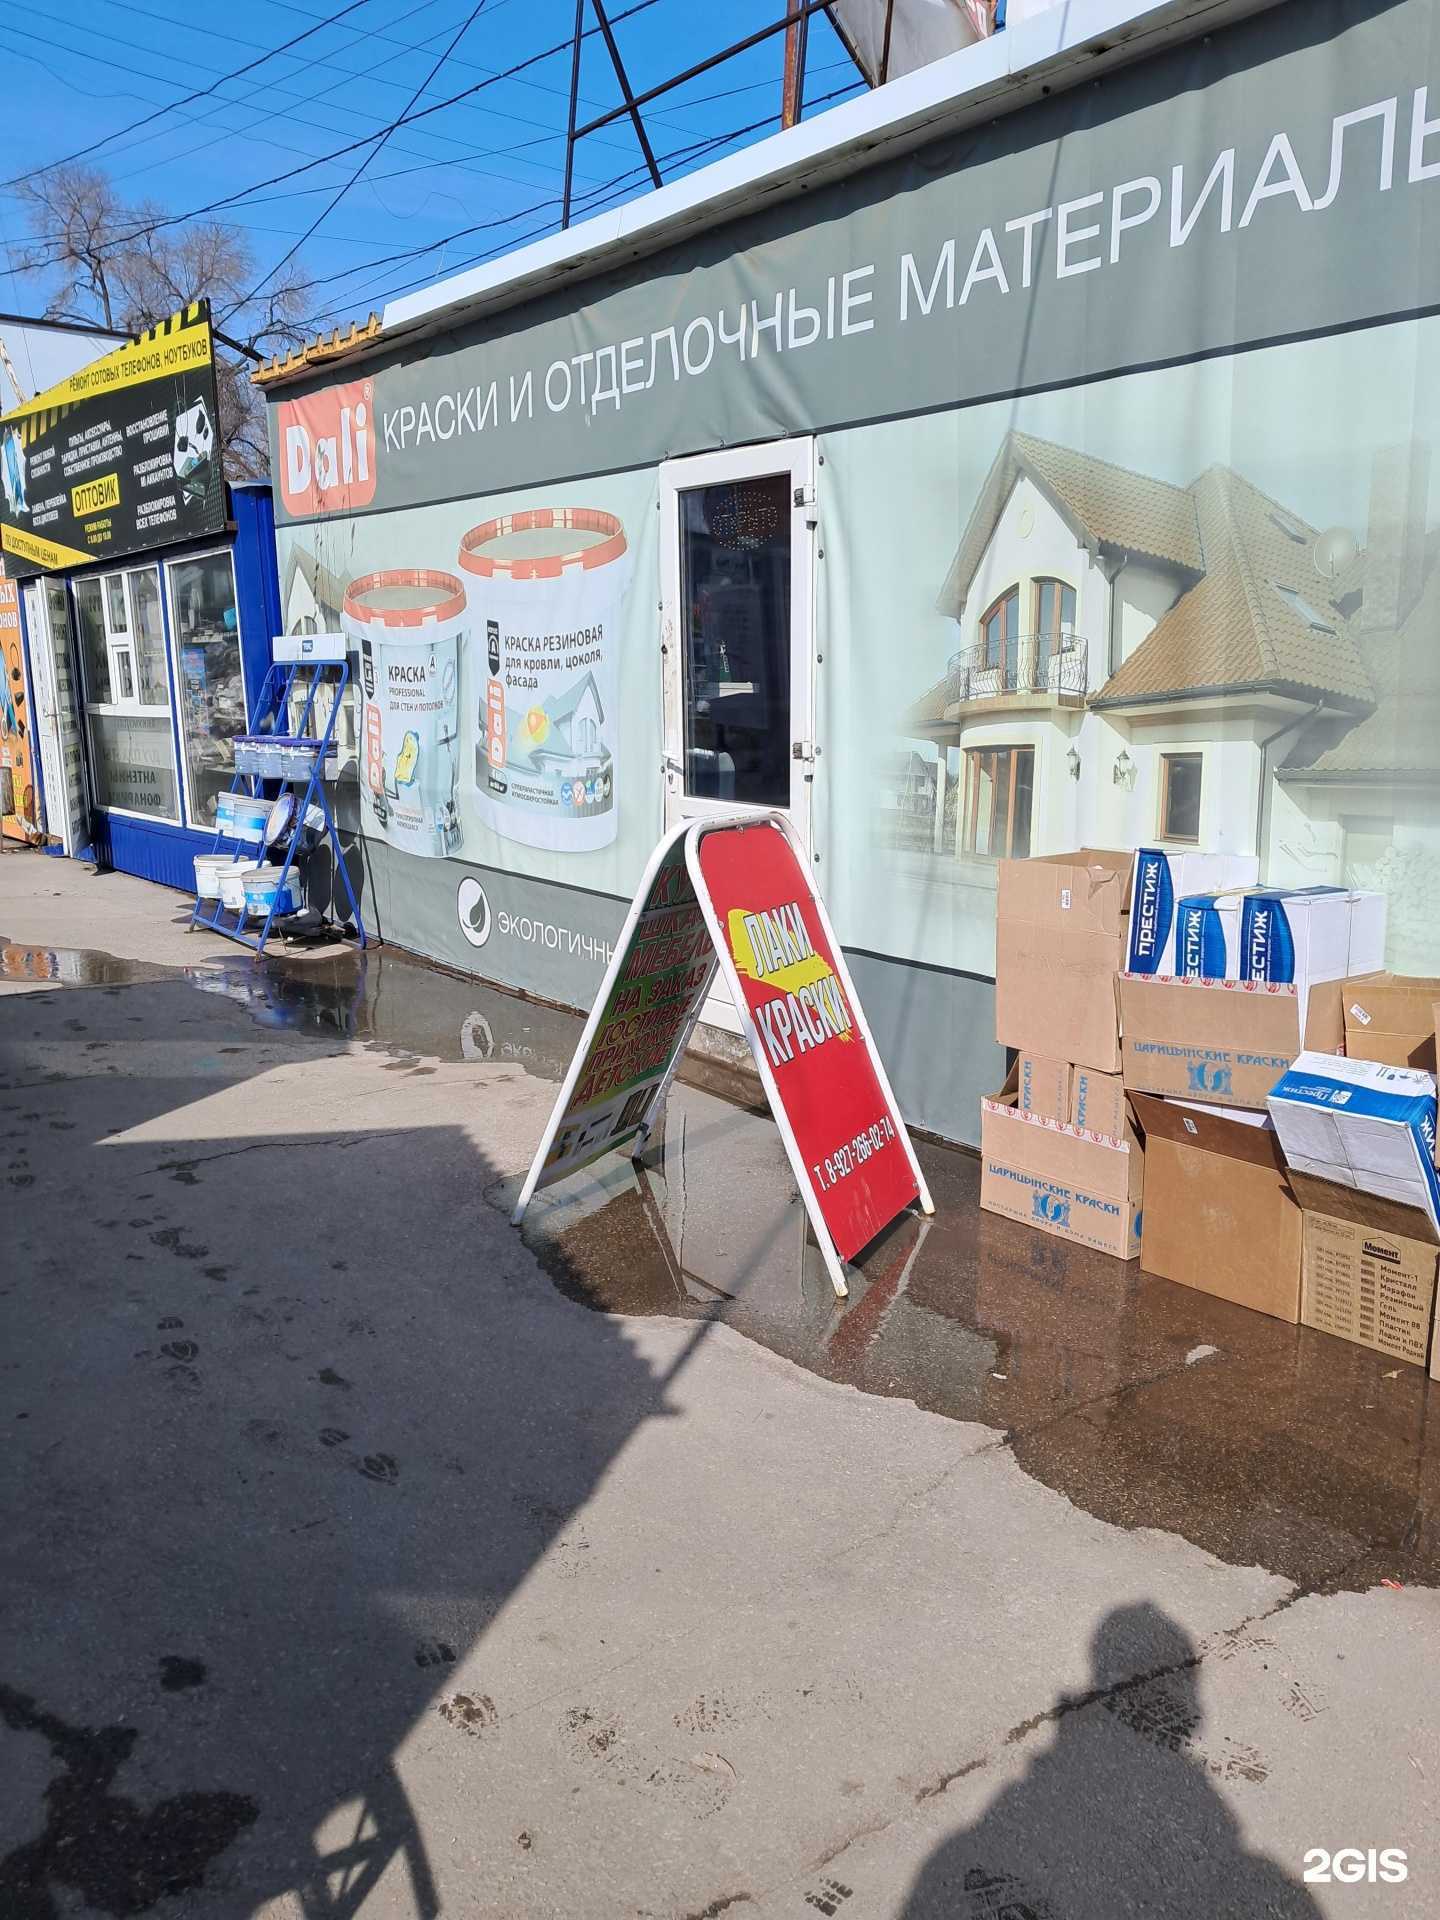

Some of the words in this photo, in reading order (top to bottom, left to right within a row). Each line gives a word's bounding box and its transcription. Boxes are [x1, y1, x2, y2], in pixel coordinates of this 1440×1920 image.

[69, 374, 90, 392] РЕМОНТ
[90, 365, 120, 386] СОТОВЫХ
[121, 353, 162, 377] ТЕЛЕФОНОВ,
[164, 339, 207, 366] НОУТБУКОВ
[382, 381, 498, 453] КРАСКИ
[510, 370, 533, 423] И
[544, 263, 875, 416] ОТДЕЛОЧНЫЕ
[126, 409, 168, 437] ВОССТАНОВЛЕНИЕ
[286, 402, 369, 494] Dali
[133, 453, 173, 476] РАЗБЛОКИРОВКА
[75, 478, 117, 512] ОПТОВИК
[137, 495, 176, 516] РАЗБЛОКИРОВКА
[136, 517, 148, 530] ВСЕХ
[149, 508, 177, 526] ТЕЛЕФОНОВ
[505, 636, 541, 652] КРАСКА
[543, 624, 603, 651] РЕЗИНОВАЯ
[388, 665, 426, 682] КРАСКА
[506, 656, 521, 670] для
[524, 657, 563, 674] кровли,
[566, 649, 603, 671] цоколя,
[389, 687, 425, 697] PROFESSIONAL
[506, 671, 538, 692] фасада
[401, 703, 413, 711] СТЕН
[1139, 862, 1159, 957] ПРЕСТИЖ
[743, 902, 816, 978] ЛАКИ
[1186, 911, 1202, 978] ЕСТИЖ
[1252, 910, 1268, 982] ЕСТИЖ
[612, 986, 641, 1017] НА
[755, 973, 852, 1068] КРАСКИ
[1134, 1042, 1231, 1063] ЦАРИЦЫНСКИЕ
[1237, 1053, 1290, 1069] КРАСКИ
[1078, 1075, 1088, 1126] КРАСКИ
[813, 1165, 831, 1191] Т.
[824, 1115, 895, 1184] 8-927-266-02-74
[989, 1163, 1071, 1200] ЦАРИЦЫНСКИЕ
[1075, 1192, 1120, 1217] КРАСКИ
[1364, 1241, 1399, 1259] Момент
[1380, 1264, 1418, 1282] Момент-1
[1380, 1275, 1417, 1291] Кристалл
[1380, 1283, 1416, 1300] Марафон
[1380, 1292, 1424, 1312] Резиновый
[1380, 1302, 1397, 1312] Гель
[1380, 1311, 1410, 1327] Момент
[1380, 1320, 1411, 1336] Пластик
[1408, 1338, 1424, 1350] ПВХ
